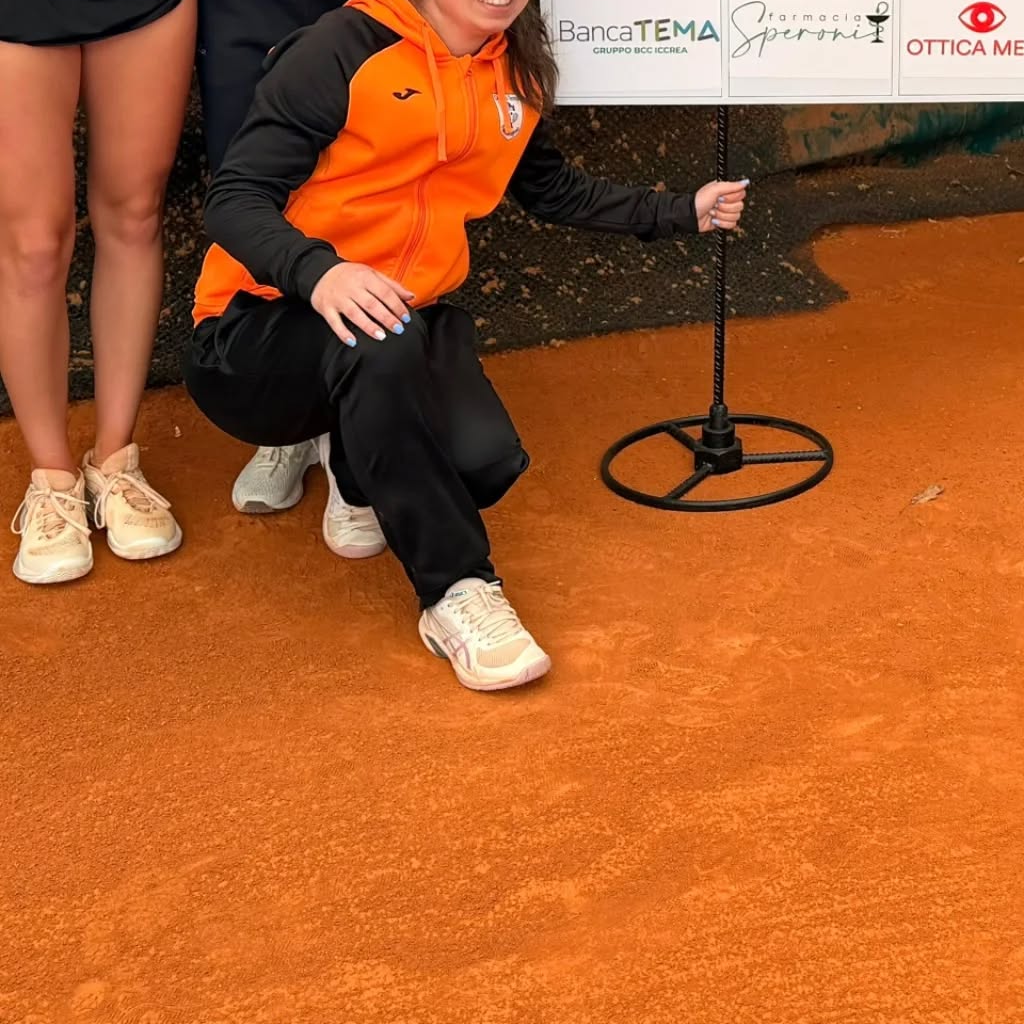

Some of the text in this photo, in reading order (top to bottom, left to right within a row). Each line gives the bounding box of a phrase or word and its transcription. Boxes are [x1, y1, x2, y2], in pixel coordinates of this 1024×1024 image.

[769, 12, 861, 21] farmacia
[731, 0, 876, 58] Speroni
[654, 46, 688, 54] ICCREA
[907, 39, 986, 56] OTTICA
